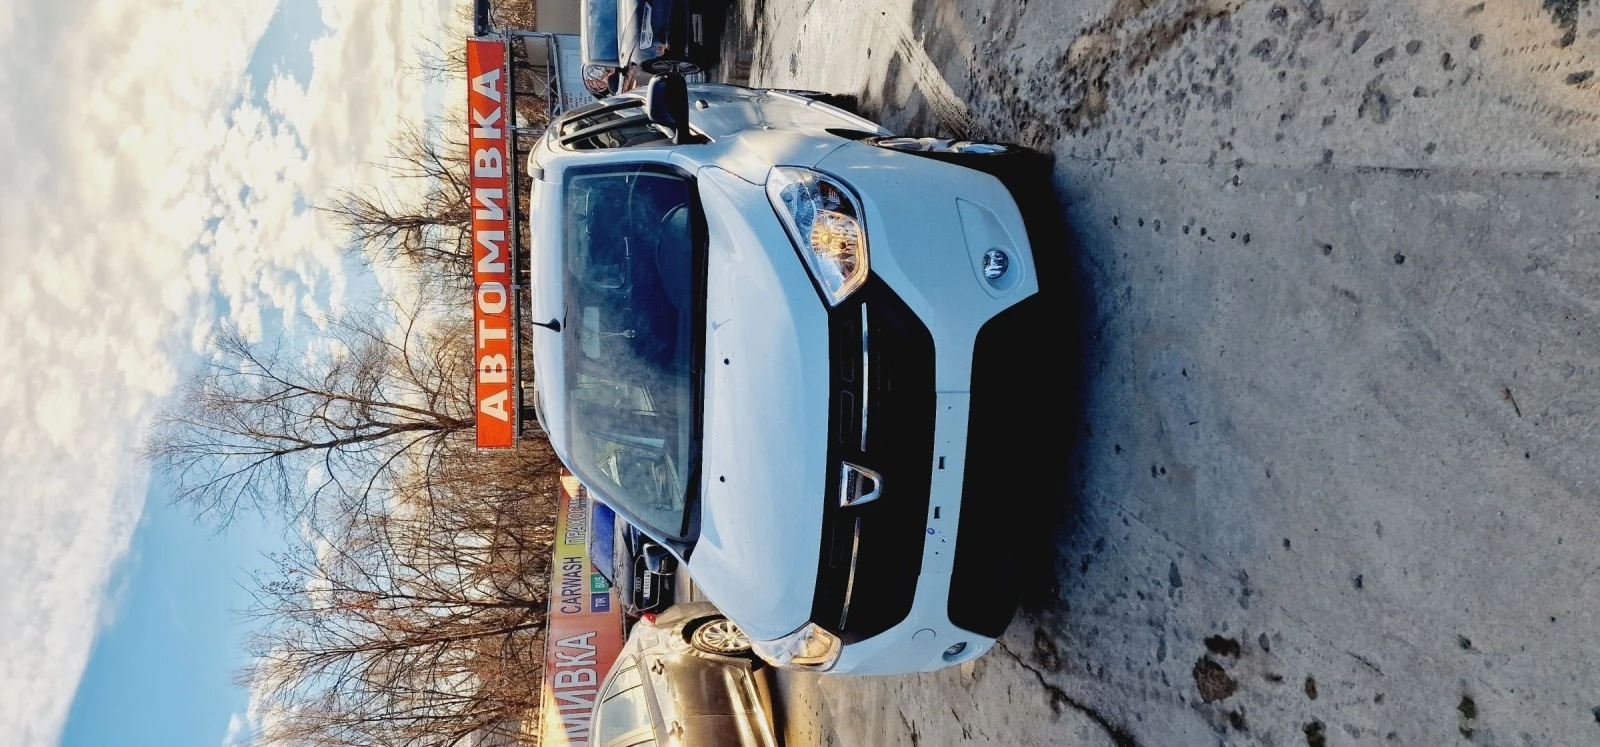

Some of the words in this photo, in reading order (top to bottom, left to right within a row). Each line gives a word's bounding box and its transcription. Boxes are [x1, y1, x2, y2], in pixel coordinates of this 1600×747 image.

[472, 67, 508, 423] АВТОМИВКА
[560, 556, 582, 614] CARWASH
[594, 576, 605, 588] BUS
[595, 597, 606, 608] TIR
[553, 631, 598, 747] МИВКА
